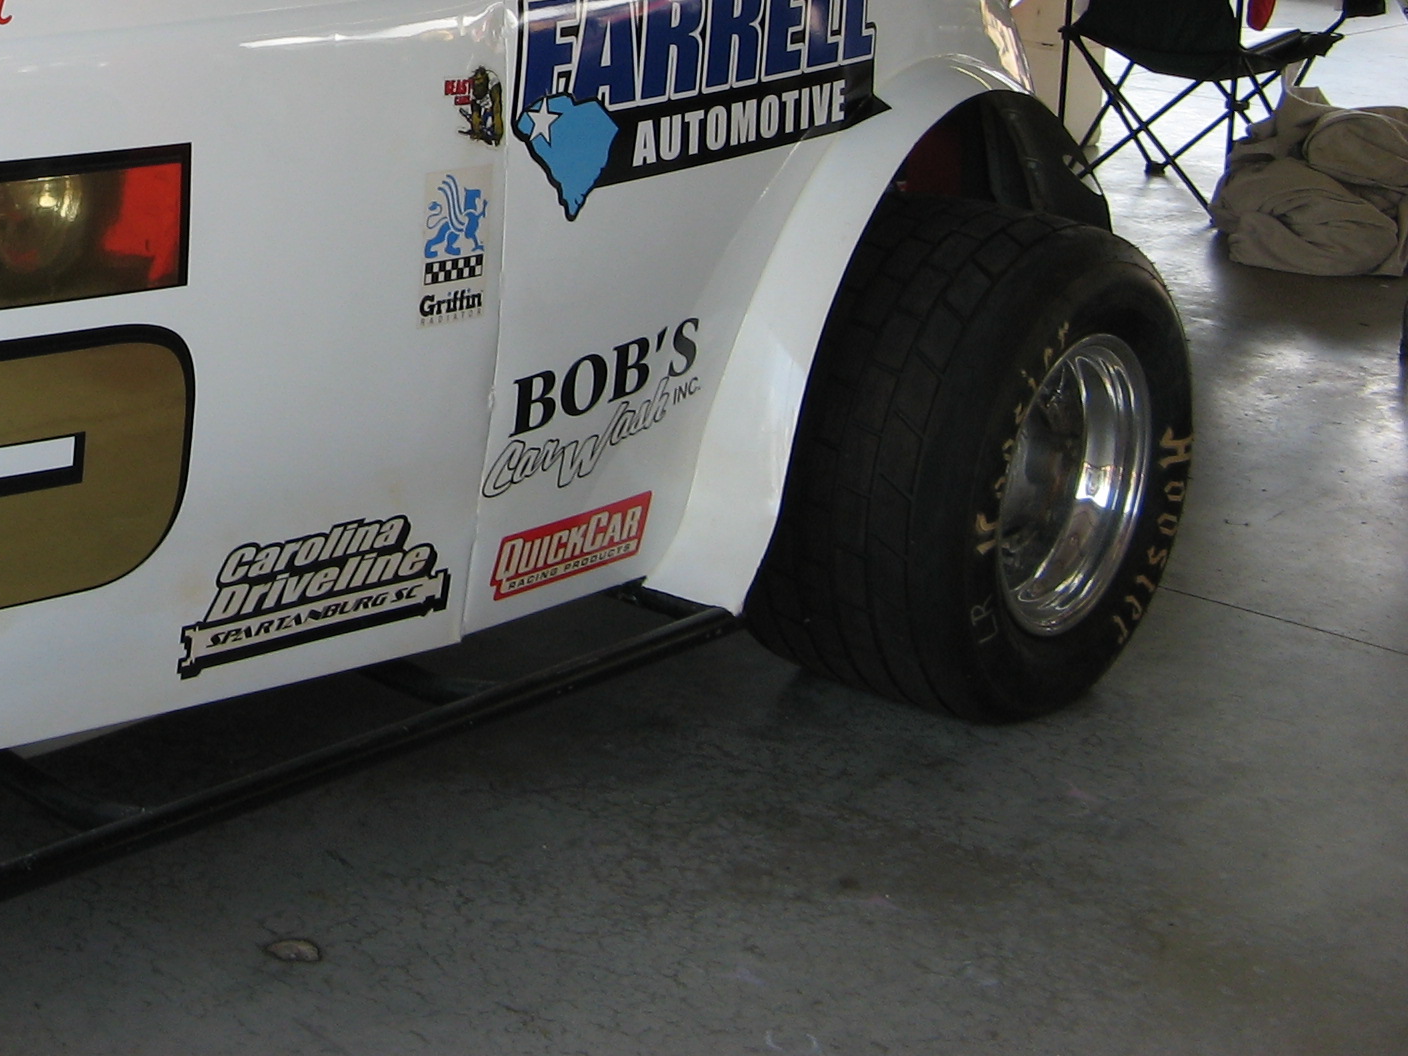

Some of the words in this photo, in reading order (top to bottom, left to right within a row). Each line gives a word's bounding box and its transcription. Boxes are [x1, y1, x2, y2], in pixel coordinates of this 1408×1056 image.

[632, 80, 846, 167] AUTOMOTIVE
[419, 288, 483, 317] Griffin
[420, 307, 482, 326] RADIATOR
[508, 317, 699, 438] BOB'S
[673, 376, 701, 405] INC.
[218, 515, 409, 585] Carolina
[507, 568, 559, 591] RACING
[563, 542, 632, 572] PRODUCTS
[204, 544, 433, 623] Driveline
[205, 592, 389, 649] SPARTANBURG
[390, 583, 425, 603] SC
